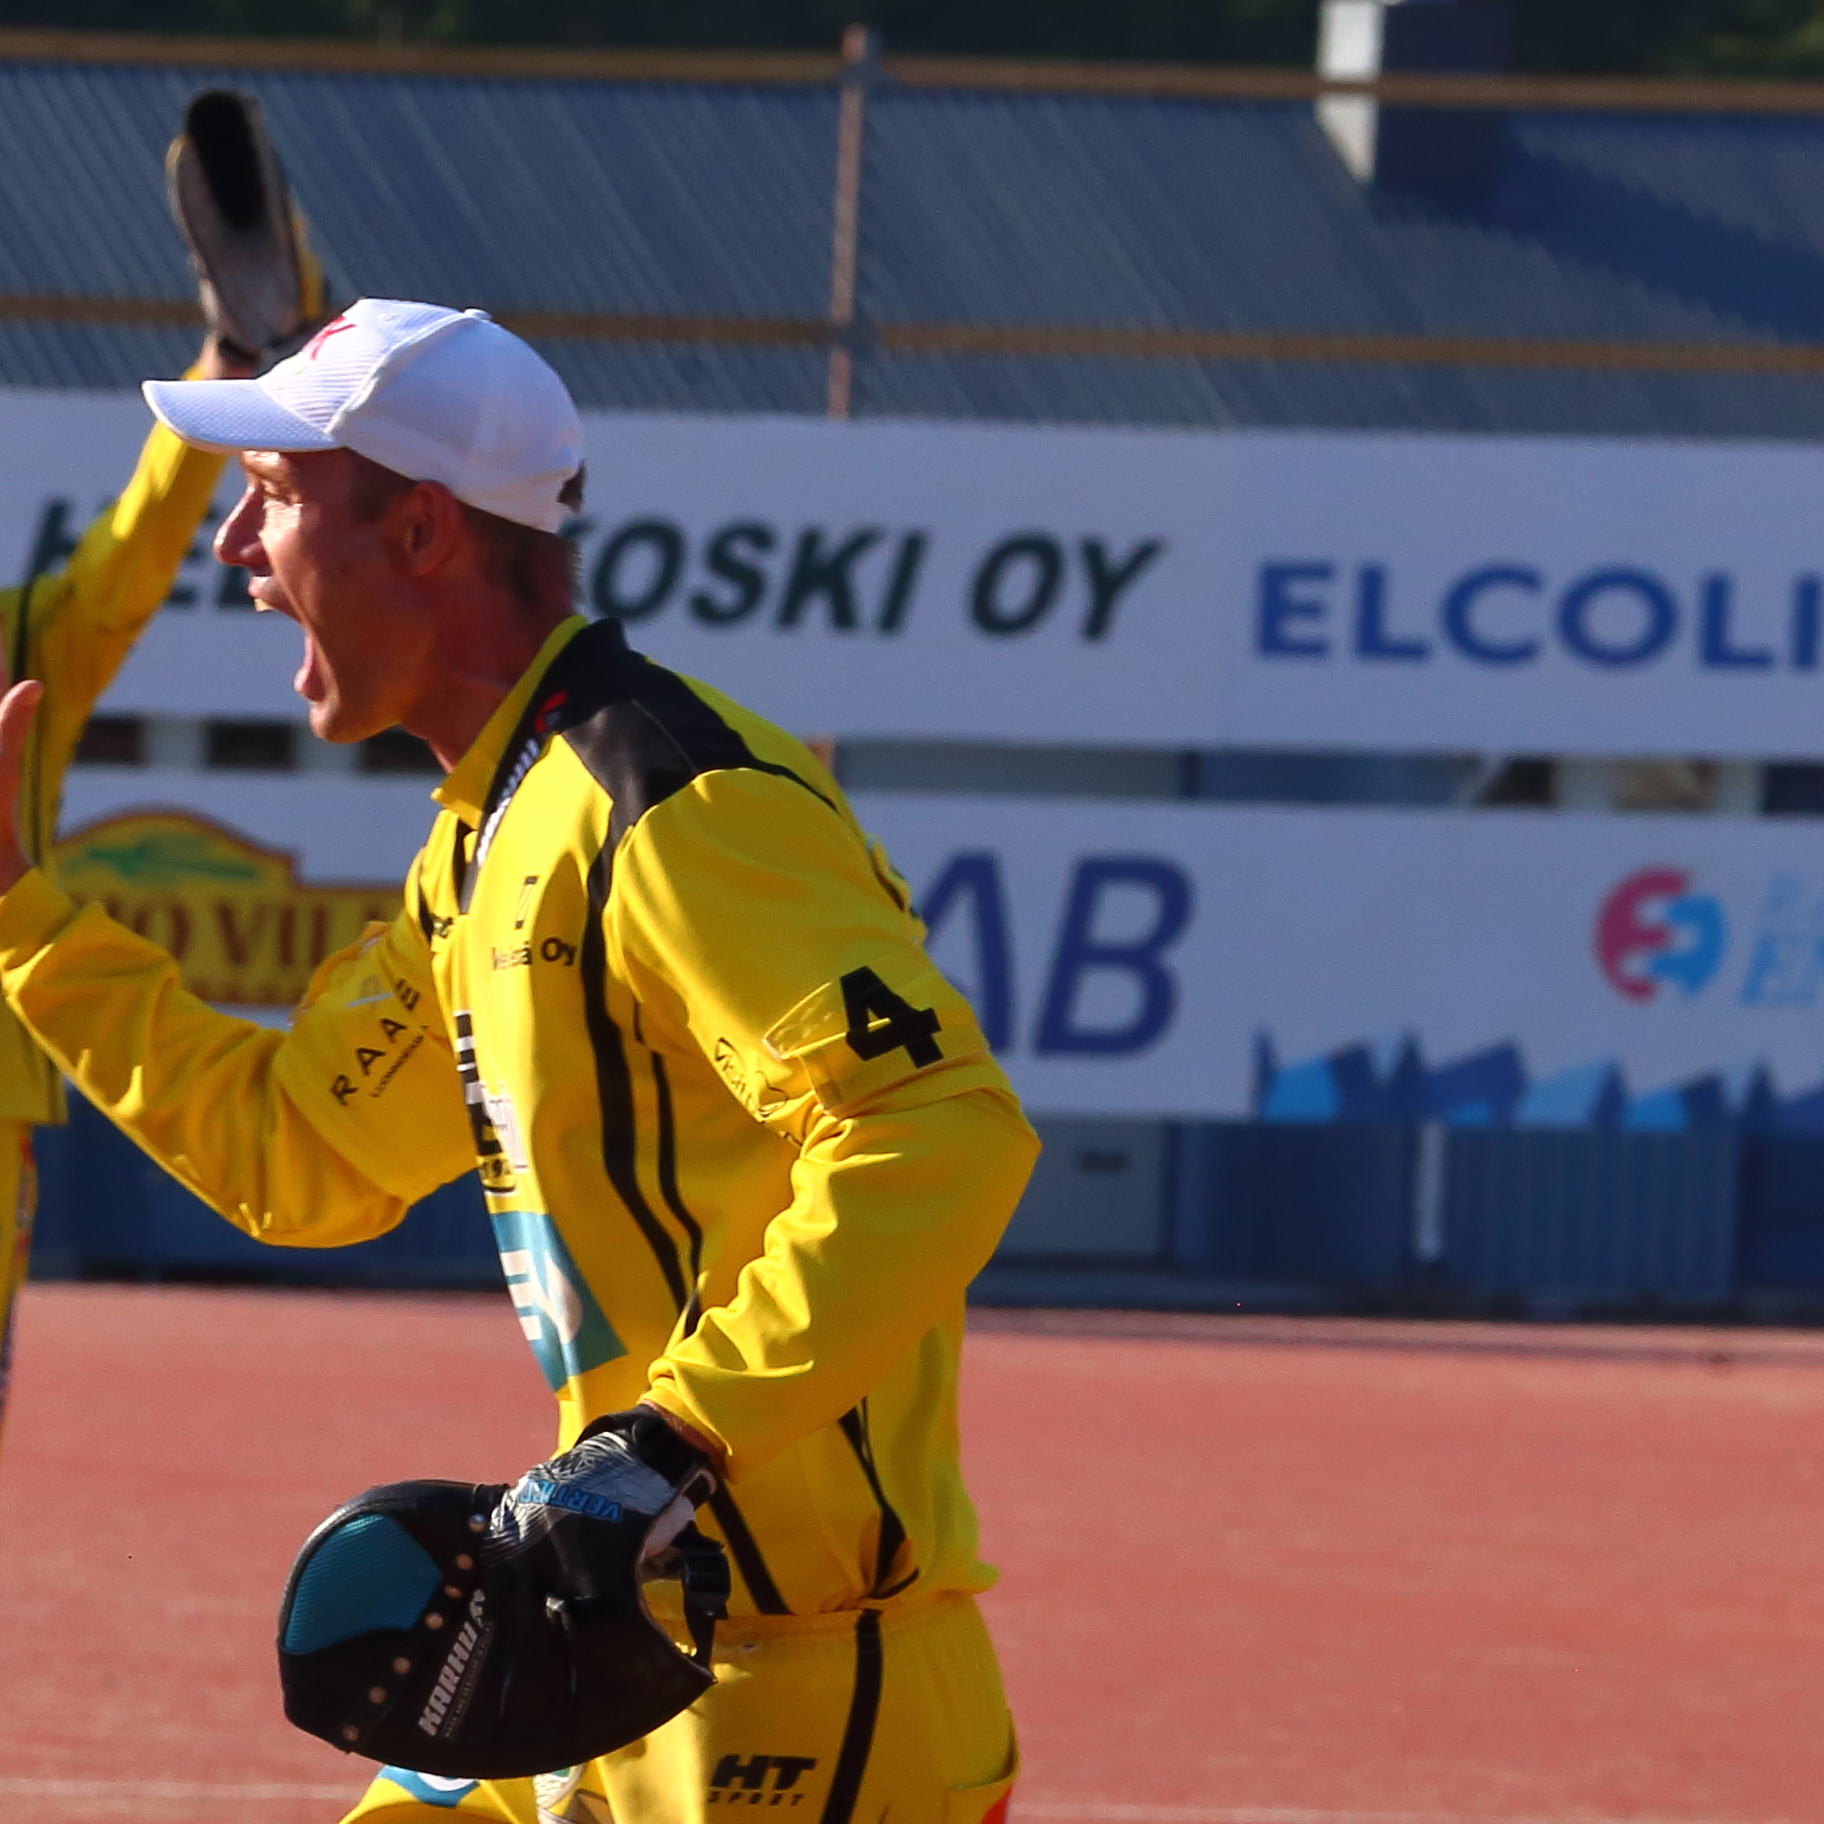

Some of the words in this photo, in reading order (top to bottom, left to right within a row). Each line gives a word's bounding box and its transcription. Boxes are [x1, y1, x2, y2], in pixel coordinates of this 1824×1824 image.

[967, 532, 1166, 645] OY
[1251, 556, 1824, 675] ELCOLI
[841, 966, 942, 1069] 4
[417, 1617, 480, 1740] KARHU
[709, 1753, 819, 1791] HT
